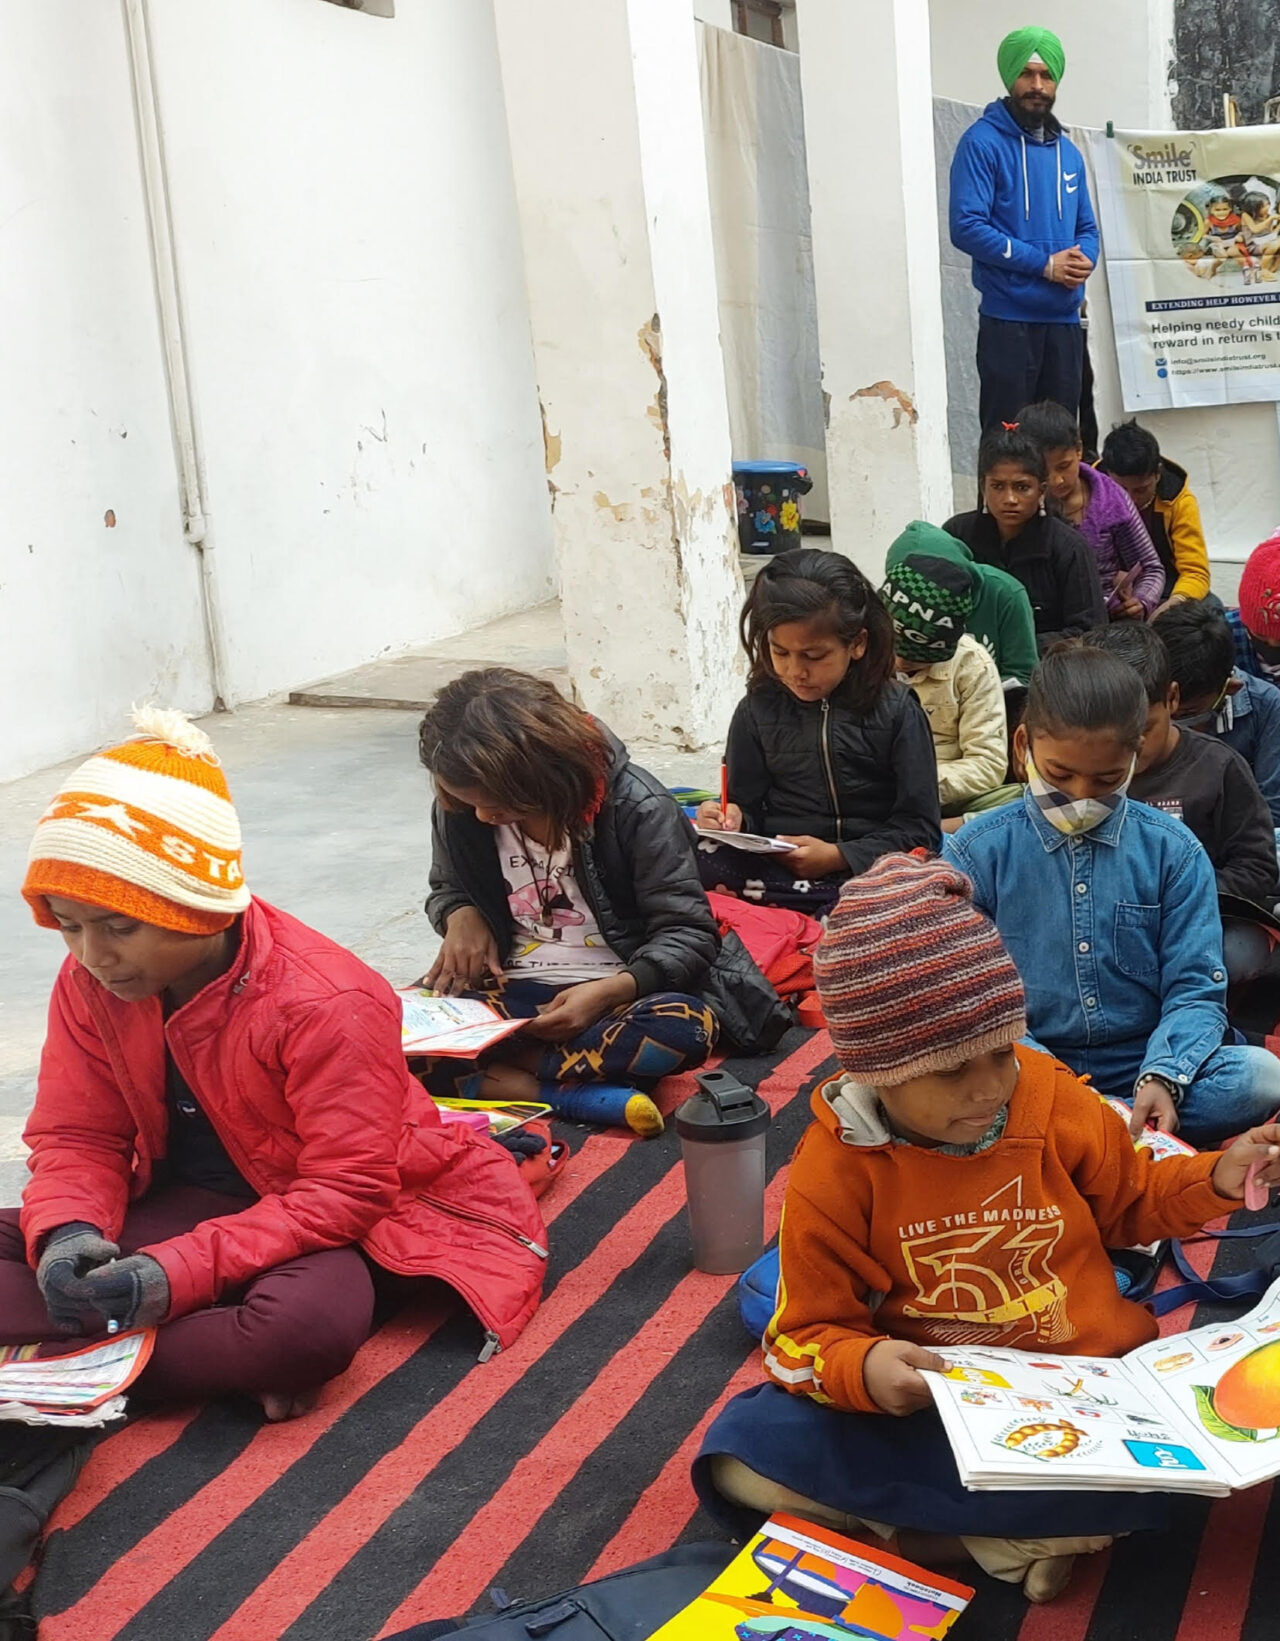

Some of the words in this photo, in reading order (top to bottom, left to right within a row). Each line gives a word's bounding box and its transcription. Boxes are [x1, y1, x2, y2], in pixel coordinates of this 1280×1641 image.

[1132, 142, 1192, 169] Smile
[1133, 171, 1163, 185] INDIA
[1166, 169, 1196, 183] TRUST
[1151, 299, 1204, 310] EXTENDING
[1206, 297, 1230, 307] HELP
[1231, 294, 1278, 305] HOWEVER
[1151, 321, 1201, 336] Helping
[1205, 318, 1245, 332] needy
[1153, 336, 1198, 349] reward
[1202, 335, 1214, 346] in
[1218, 332, 1258, 345] return
[1261, 331, 1273, 342] is
[882, 582, 954, 629] APNA
[892, 618, 946, 649] EGA
[160, 834, 242, 882] STA
[898, 1219, 937, 1239] LIVE
[941, 1211, 977, 1228] THE
[983, 1204, 1062, 1223] MADNESS
